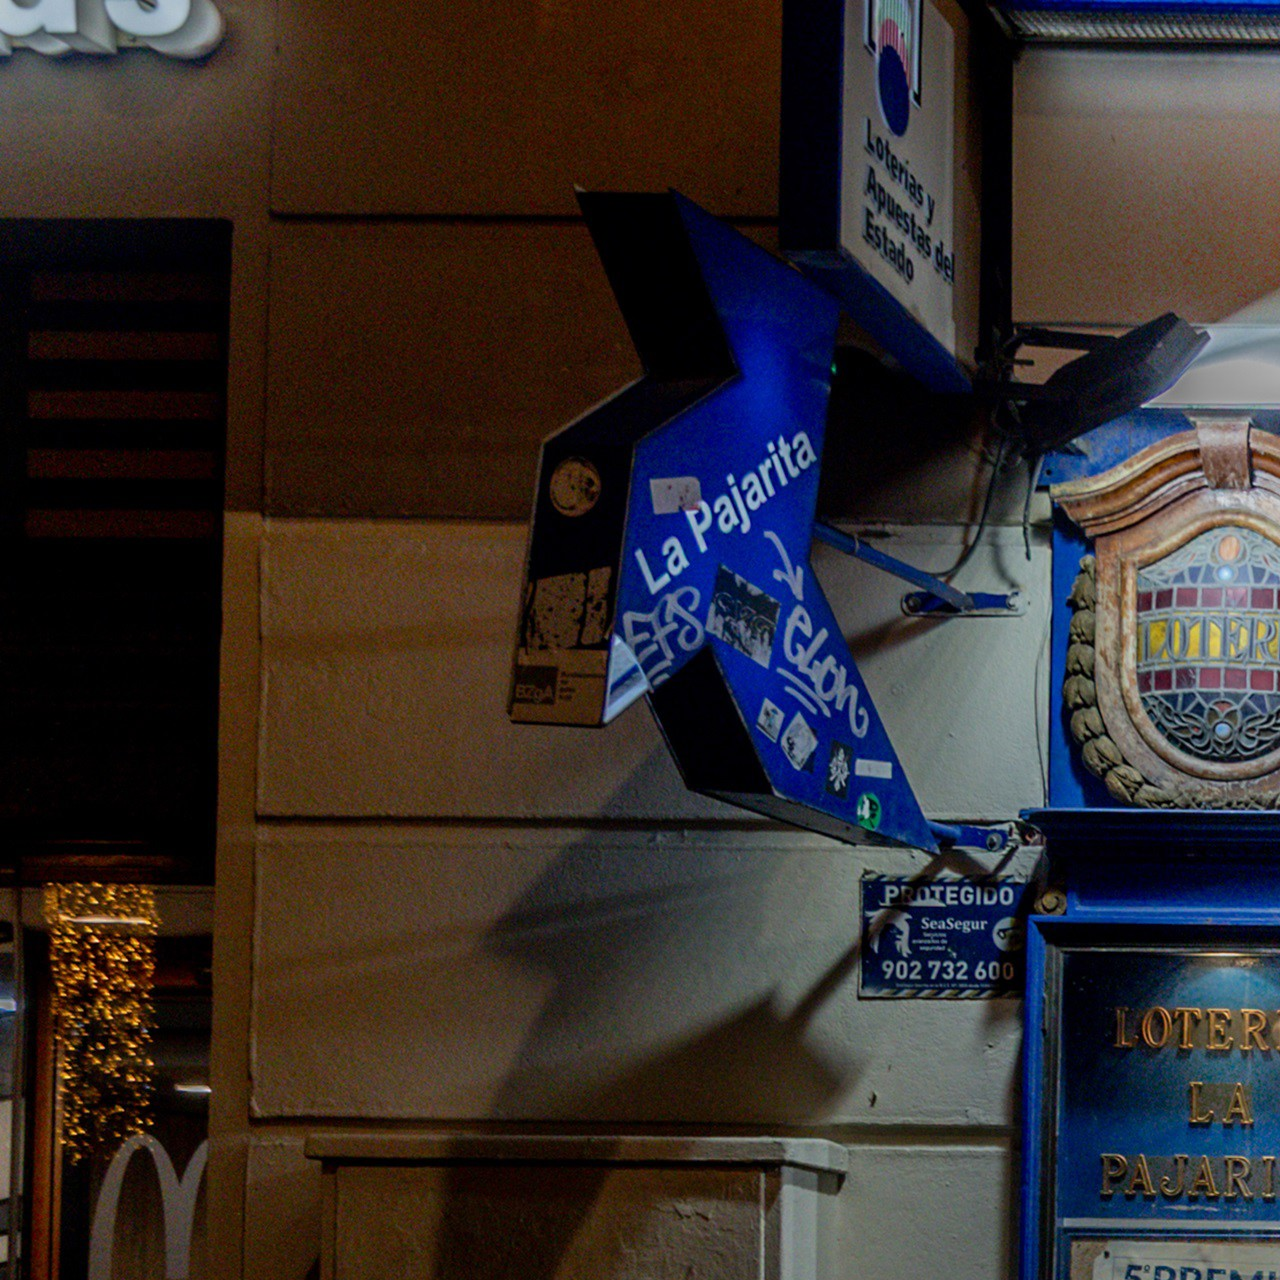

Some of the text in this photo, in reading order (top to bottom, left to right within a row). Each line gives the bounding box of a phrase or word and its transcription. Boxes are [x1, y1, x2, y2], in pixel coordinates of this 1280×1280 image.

[865, 165, 956, 283] Apuestas del
[925, 194, 936, 226] y
[863, 207, 915, 282] Estado
[634, 430, 818, 595] La Pajarita
[884, 885, 1014, 906] PROTEGIDO
[920, 916, 988, 933] SeaSegur
[882, 959, 1014, 981] 902 732 600
[1189, 1081, 1254, 1126] LA
